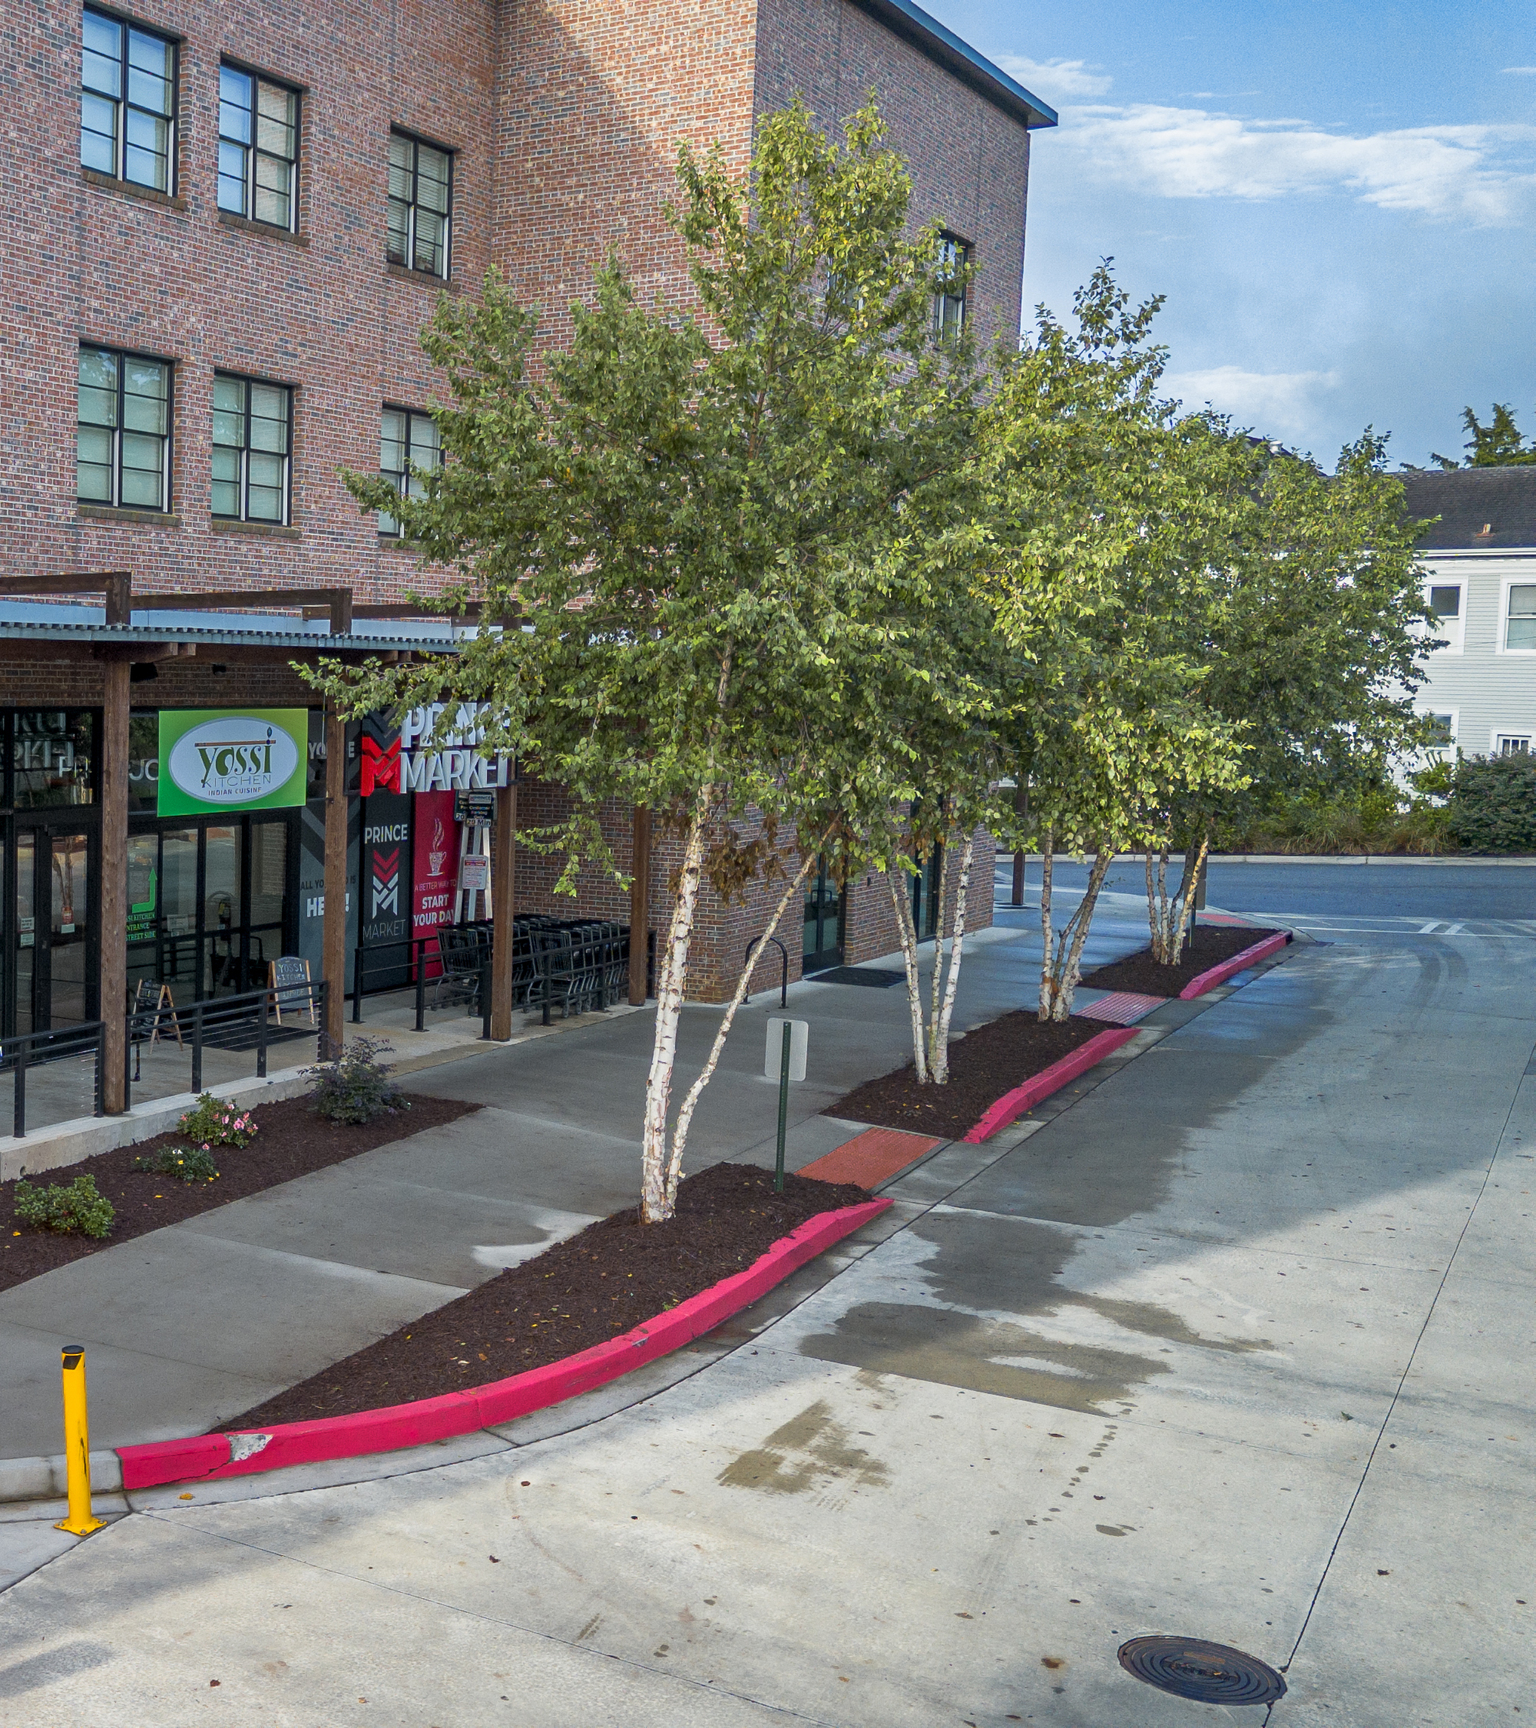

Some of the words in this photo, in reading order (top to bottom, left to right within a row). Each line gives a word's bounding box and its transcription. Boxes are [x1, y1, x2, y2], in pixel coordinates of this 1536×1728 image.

[399, 748, 514, 794] MARKET
[203, 774, 272, 788] KITCHEN
[235, 787, 262, 795] CUISINE
[364, 823, 408, 844] PRINCE
[315, 879, 325, 889] YO
[419, 881, 438, 892] BETTER
[306, 892, 350, 918] HE!
[422, 893, 450, 910] START
[126, 922, 150, 931] NTRANCE
[413, 911, 437, 927] YOUR
[363, 919, 406, 941] MARKET
